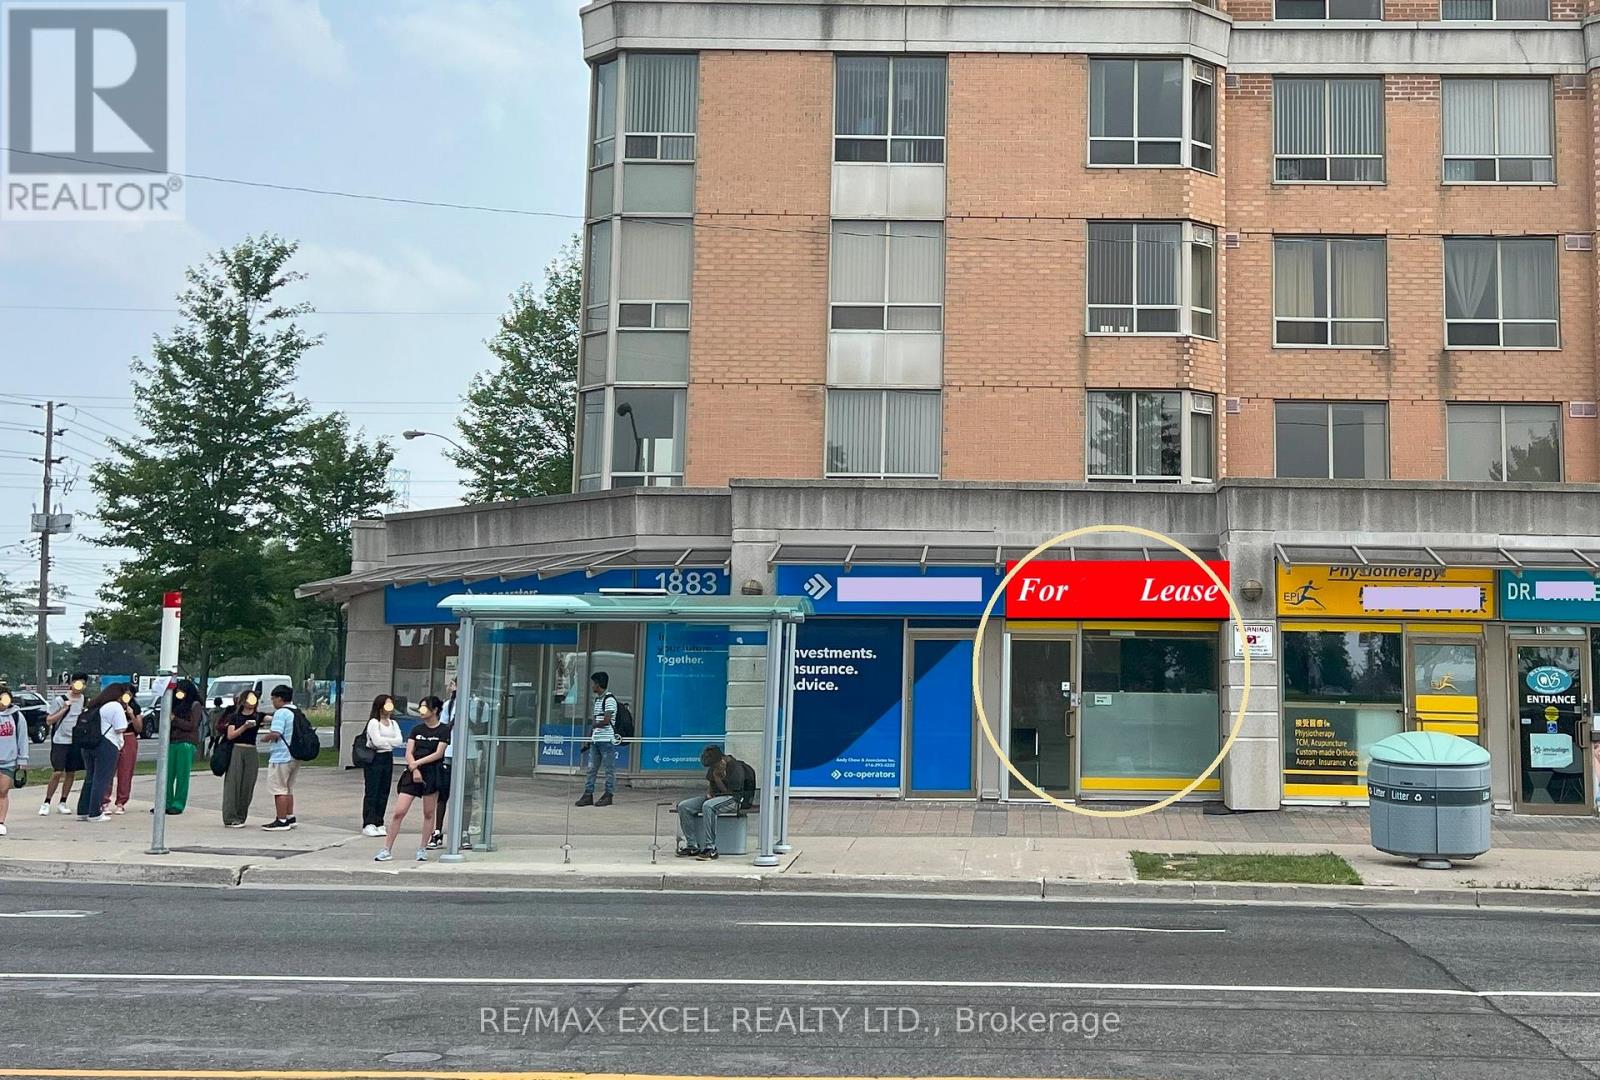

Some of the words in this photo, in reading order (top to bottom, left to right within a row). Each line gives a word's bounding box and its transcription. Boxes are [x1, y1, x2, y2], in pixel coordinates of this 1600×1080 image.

[1329, 566, 1441, 580] Phyiotherapy
[655, 572, 717, 595] 1883
[1507, 582, 1536, 601] DR.
[794, 648, 877, 659] nvestments.
[656, 654, 704, 666] Together.
[794, 665, 859, 675] nsurance.
[1526, 695, 1577, 704] ENTRANCE
[1295, 729, 1336, 740] Physiotherapy
[1310, 739, 1347, 749] Acupuncture
[1296, 758, 1316, 768] Accept
[1318, 759, 1347, 767] Insurance
[843, 771, 896, 780] co-operators
[1391, 790, 1410, 801] Litter
